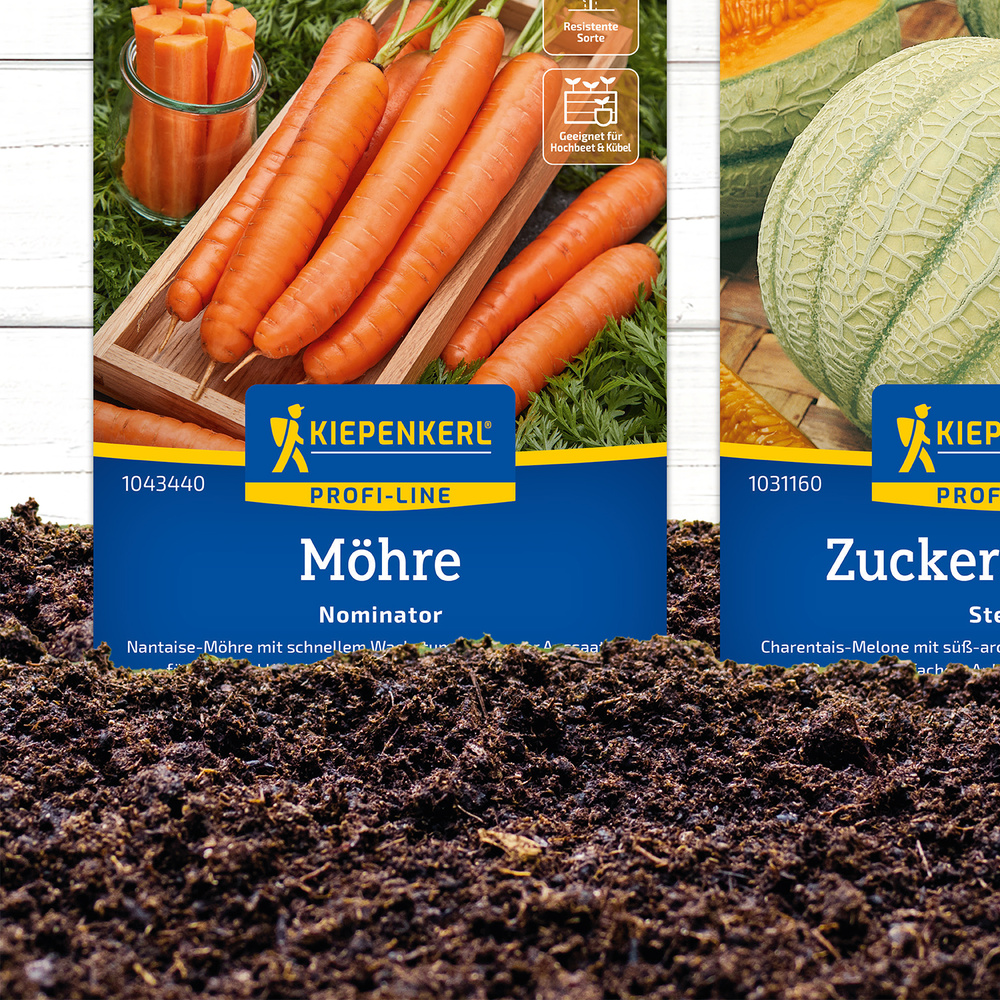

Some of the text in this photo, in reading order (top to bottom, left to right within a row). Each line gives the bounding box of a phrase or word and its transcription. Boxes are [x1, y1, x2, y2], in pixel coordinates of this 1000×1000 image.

[563, 21, 619, 32] Resistente
[576, 33, 605, 43] Sorte
[559, 131, 623, 143] Geeignet für
[550, 143, 632, 153] Hochbeet & Kübel
[121, 475, 205, 492] 1043440
[748, 475, 822, 492] 1031160
[310, 486, 451, 504] PROFI-LINE
[300, 536, 461, 582] Möhre
[319, 605, 443, 624] Nominator
[127, 640, 253, 654] Nantaise-Möhre
[257, 640, 283, 654] mit
[286, 640, 366, 654] schnellem
[761, 640, 910, 654] Charentais-Melone
[914, 640, 939, 654] mit
